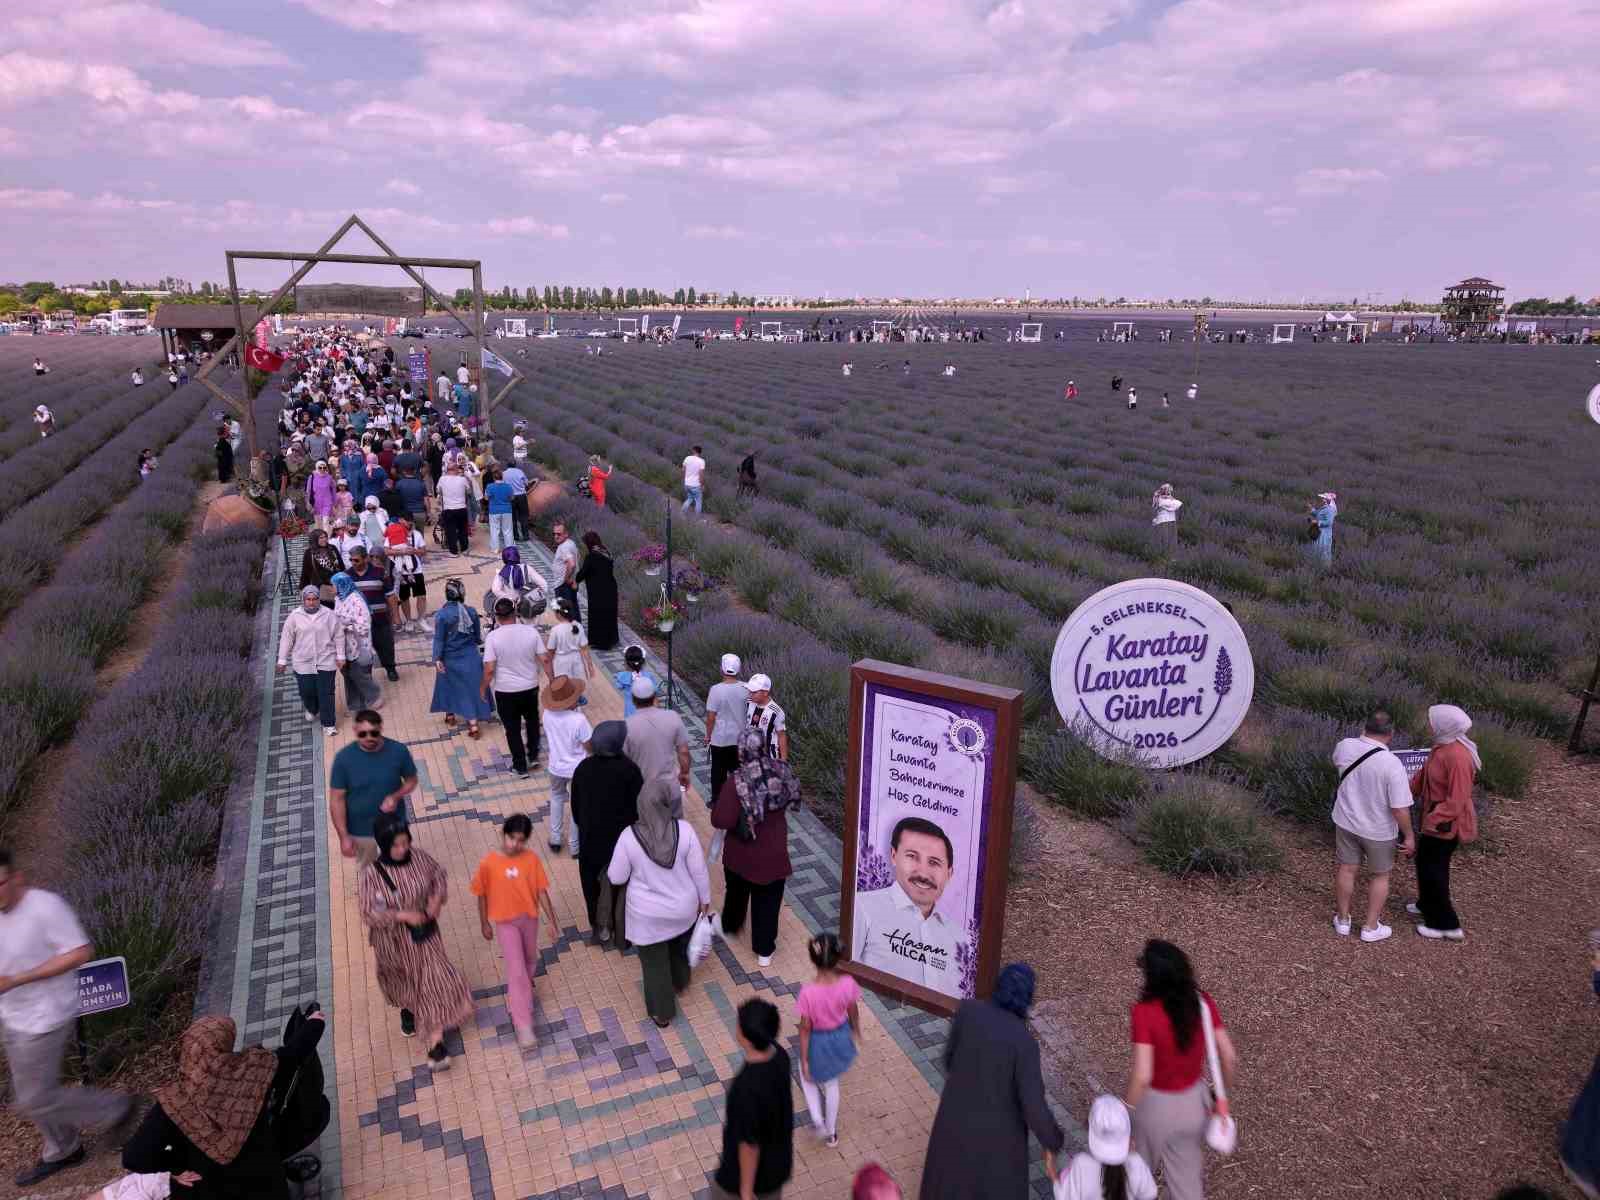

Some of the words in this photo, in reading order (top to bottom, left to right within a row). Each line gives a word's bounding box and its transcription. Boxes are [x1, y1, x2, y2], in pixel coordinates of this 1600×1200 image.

[1090, 623, 1105, 636] 5.
[1102, 601, 1188, 626] GELENEKSEL
[1105, 630, 1209, 662] Karatay
[1081, 659, 1187, 693] Lavanta
[1104, 687, 1204, 722] Günleri
[891, 728, 938, 756] Karatay
[1134, 731, 1178, 749] 2026
[890, 748, 936, 772] Lavanta
[912, 794, 959, 817] Geldiniz
[882, 929, 948, 956] Hasan
